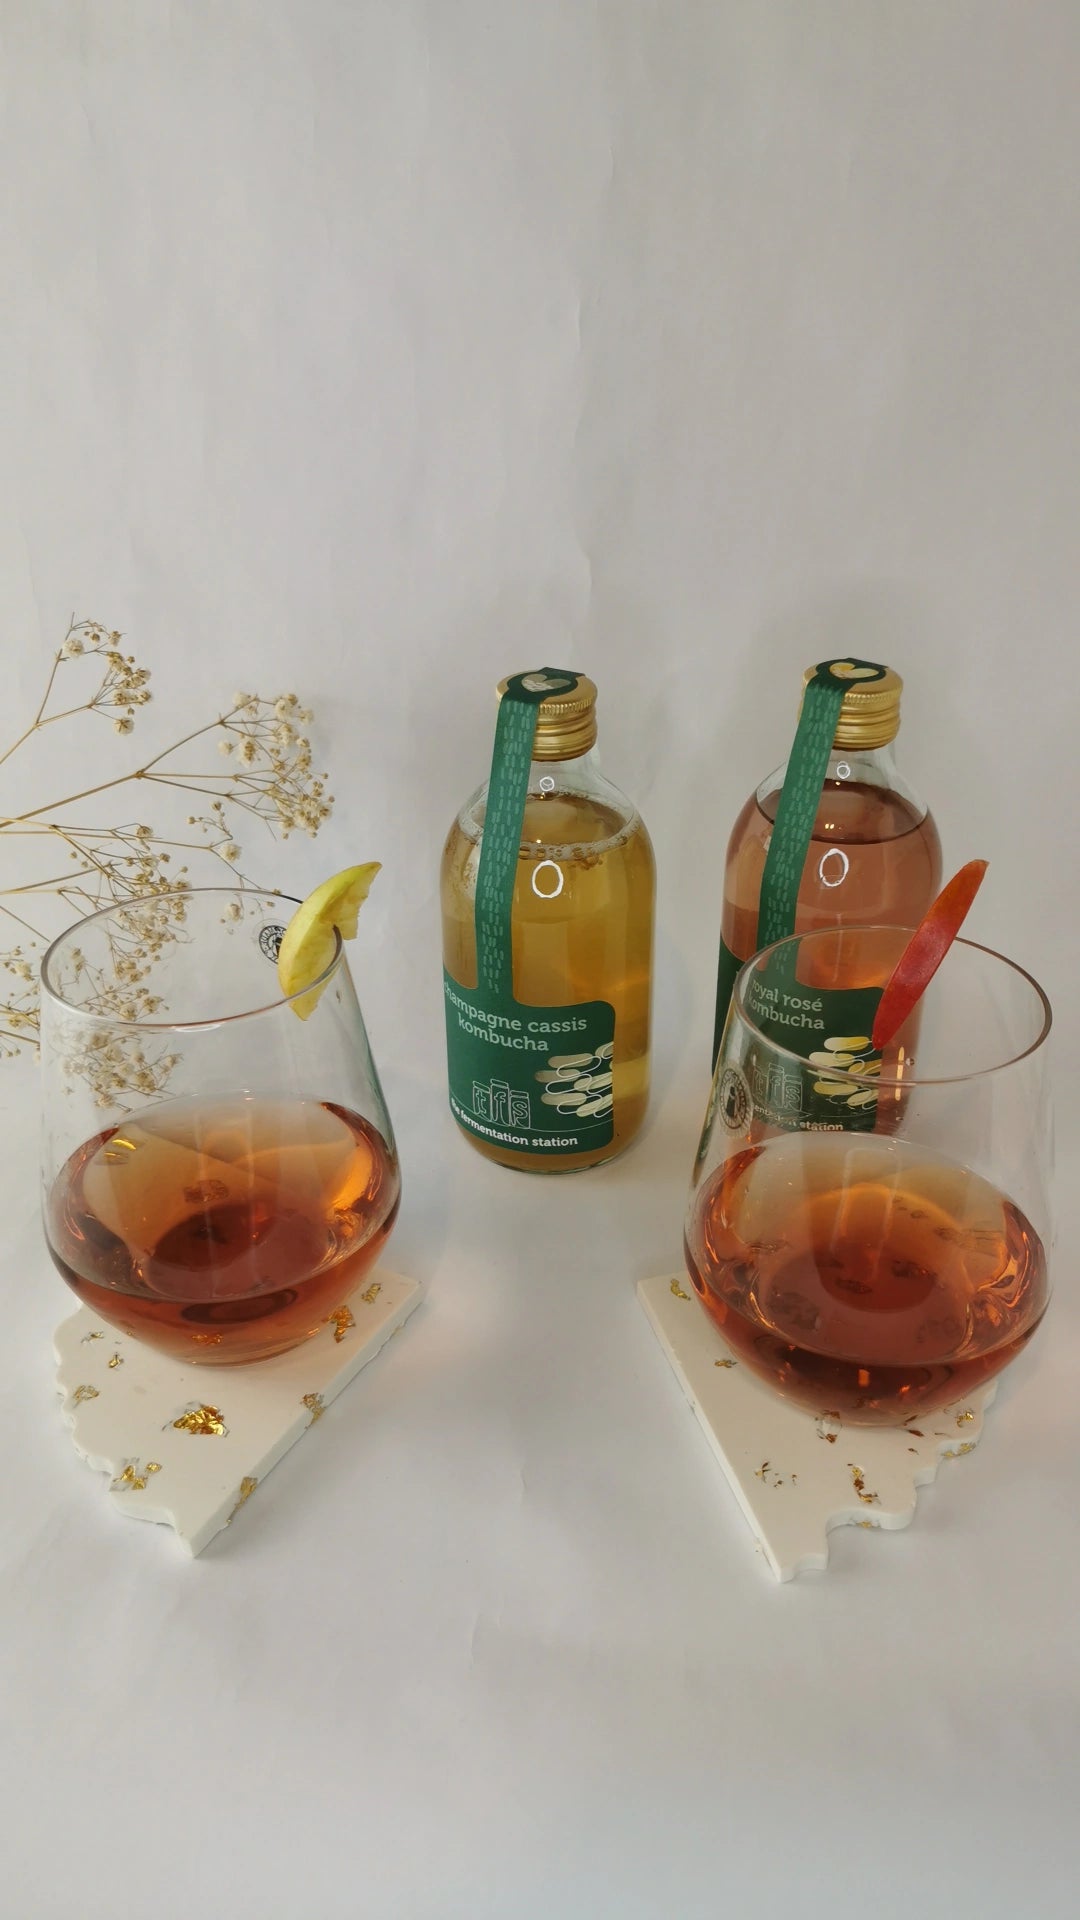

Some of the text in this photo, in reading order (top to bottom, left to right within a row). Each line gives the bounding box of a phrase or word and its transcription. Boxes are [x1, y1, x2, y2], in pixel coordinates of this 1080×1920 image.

[783, 994, 823, 1012] rosé
[458, 1012, 549, 1051] kombucha
[528, 1017, 587, 1033] cassis
[460, 1109, 529, 1146] fermentation
[532, 1135, 578, 1147] station
